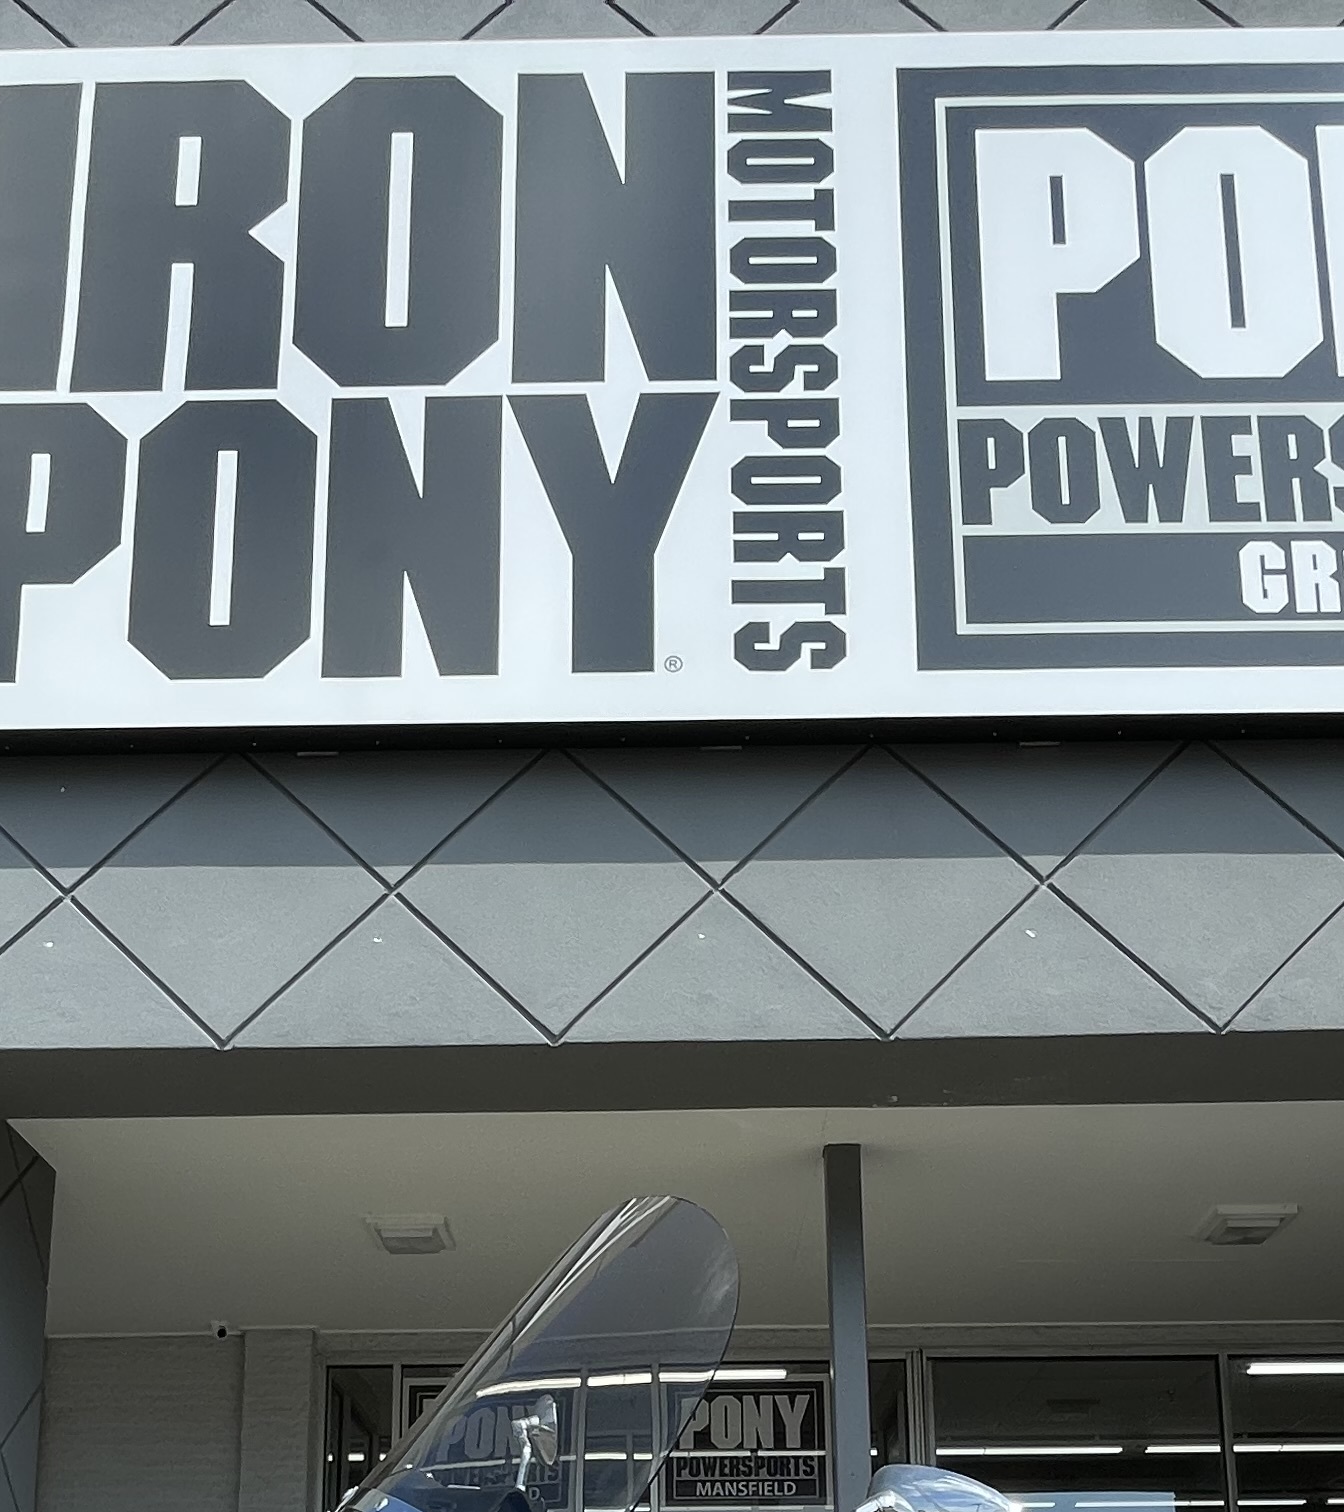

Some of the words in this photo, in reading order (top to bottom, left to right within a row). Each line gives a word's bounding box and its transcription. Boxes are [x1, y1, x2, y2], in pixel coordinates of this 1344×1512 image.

[726, 69, 848, 672] MOTORSPORTS
[436, 1405, 541, 1462] PON
[678, 1394, 811, 1449] PONY
[675, 1455, 815, 1479] POWERSPORTS
[695, 1481, 797, 1498] MANSFIELD
